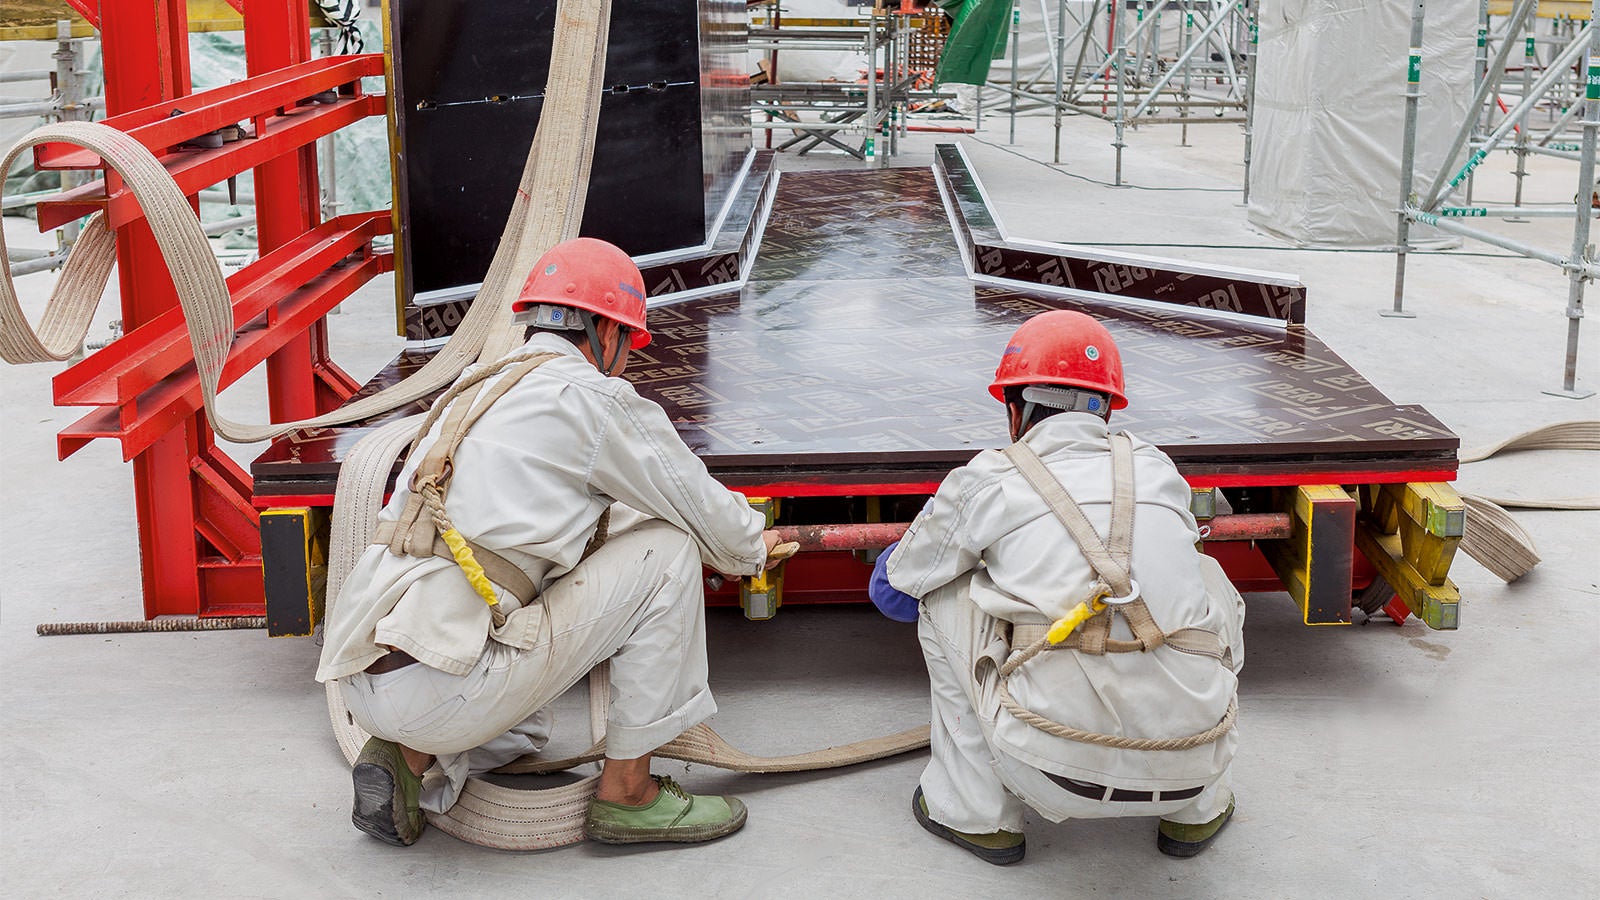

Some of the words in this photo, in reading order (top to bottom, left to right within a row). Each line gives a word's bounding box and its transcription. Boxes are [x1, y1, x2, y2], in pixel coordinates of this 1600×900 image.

[1253, 352, 1324, 371] PERI
[622, 364, 700, 382] PERI
[1259, 382, 1336, 404] PERI
